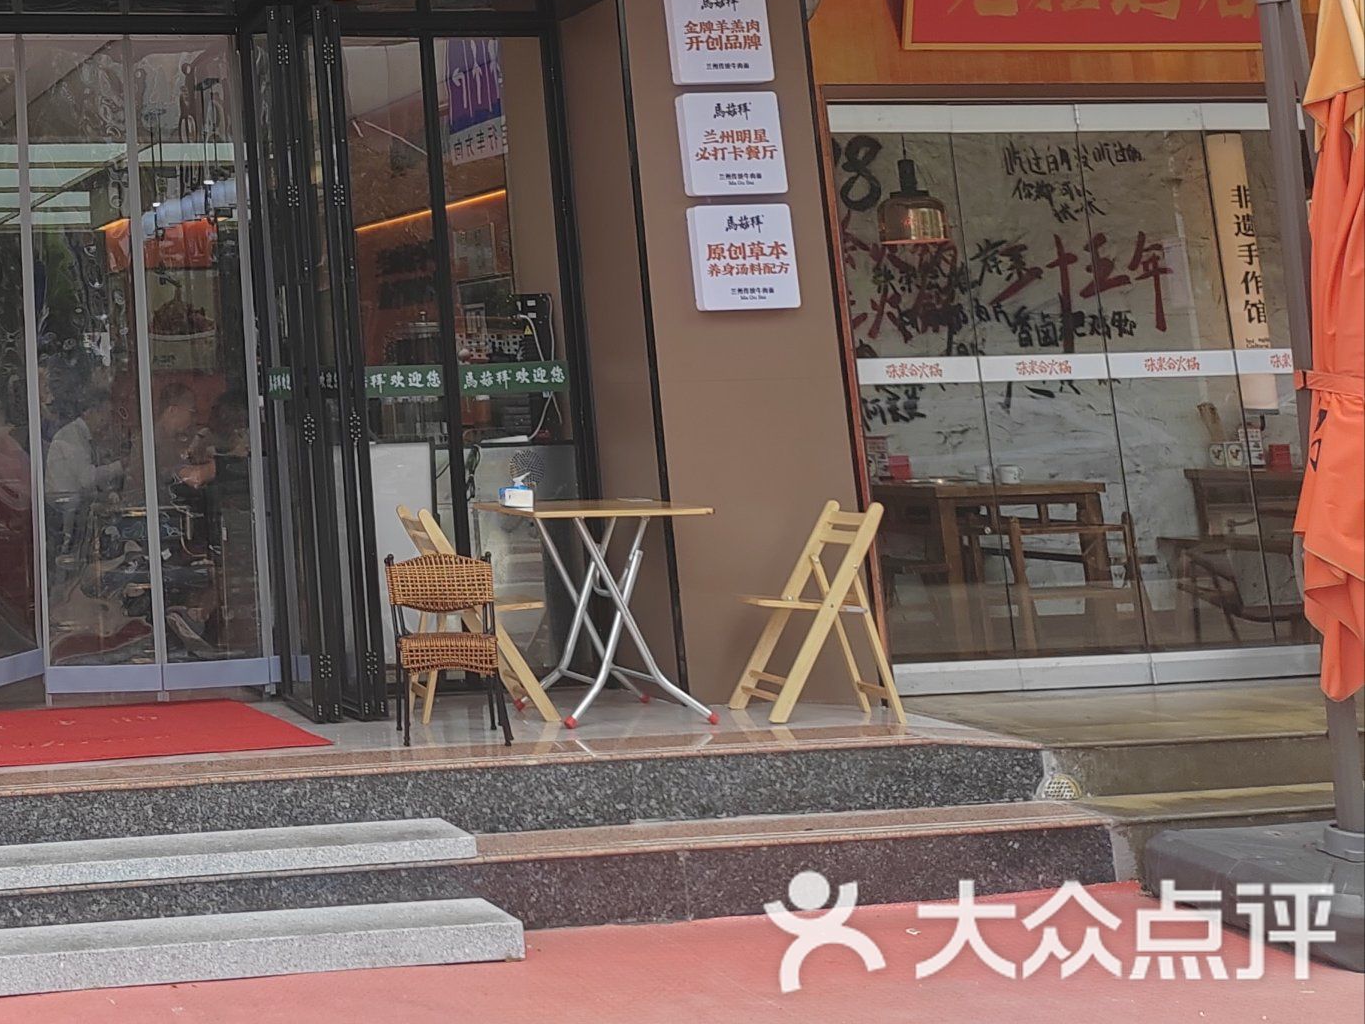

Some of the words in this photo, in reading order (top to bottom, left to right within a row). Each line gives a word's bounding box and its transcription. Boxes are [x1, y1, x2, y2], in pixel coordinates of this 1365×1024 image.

[684, 19, 760, 34] 金牌羊羔肉
[685, 34, 763, 51] 开创品牌
[702, 128, 770, 144] 兰州明星
[695, 144, 778, 161] 必打卡餐厅
[706, 241, 788, 261] 原创草本
[707, 262, 790, 277] 养身汤料配方
